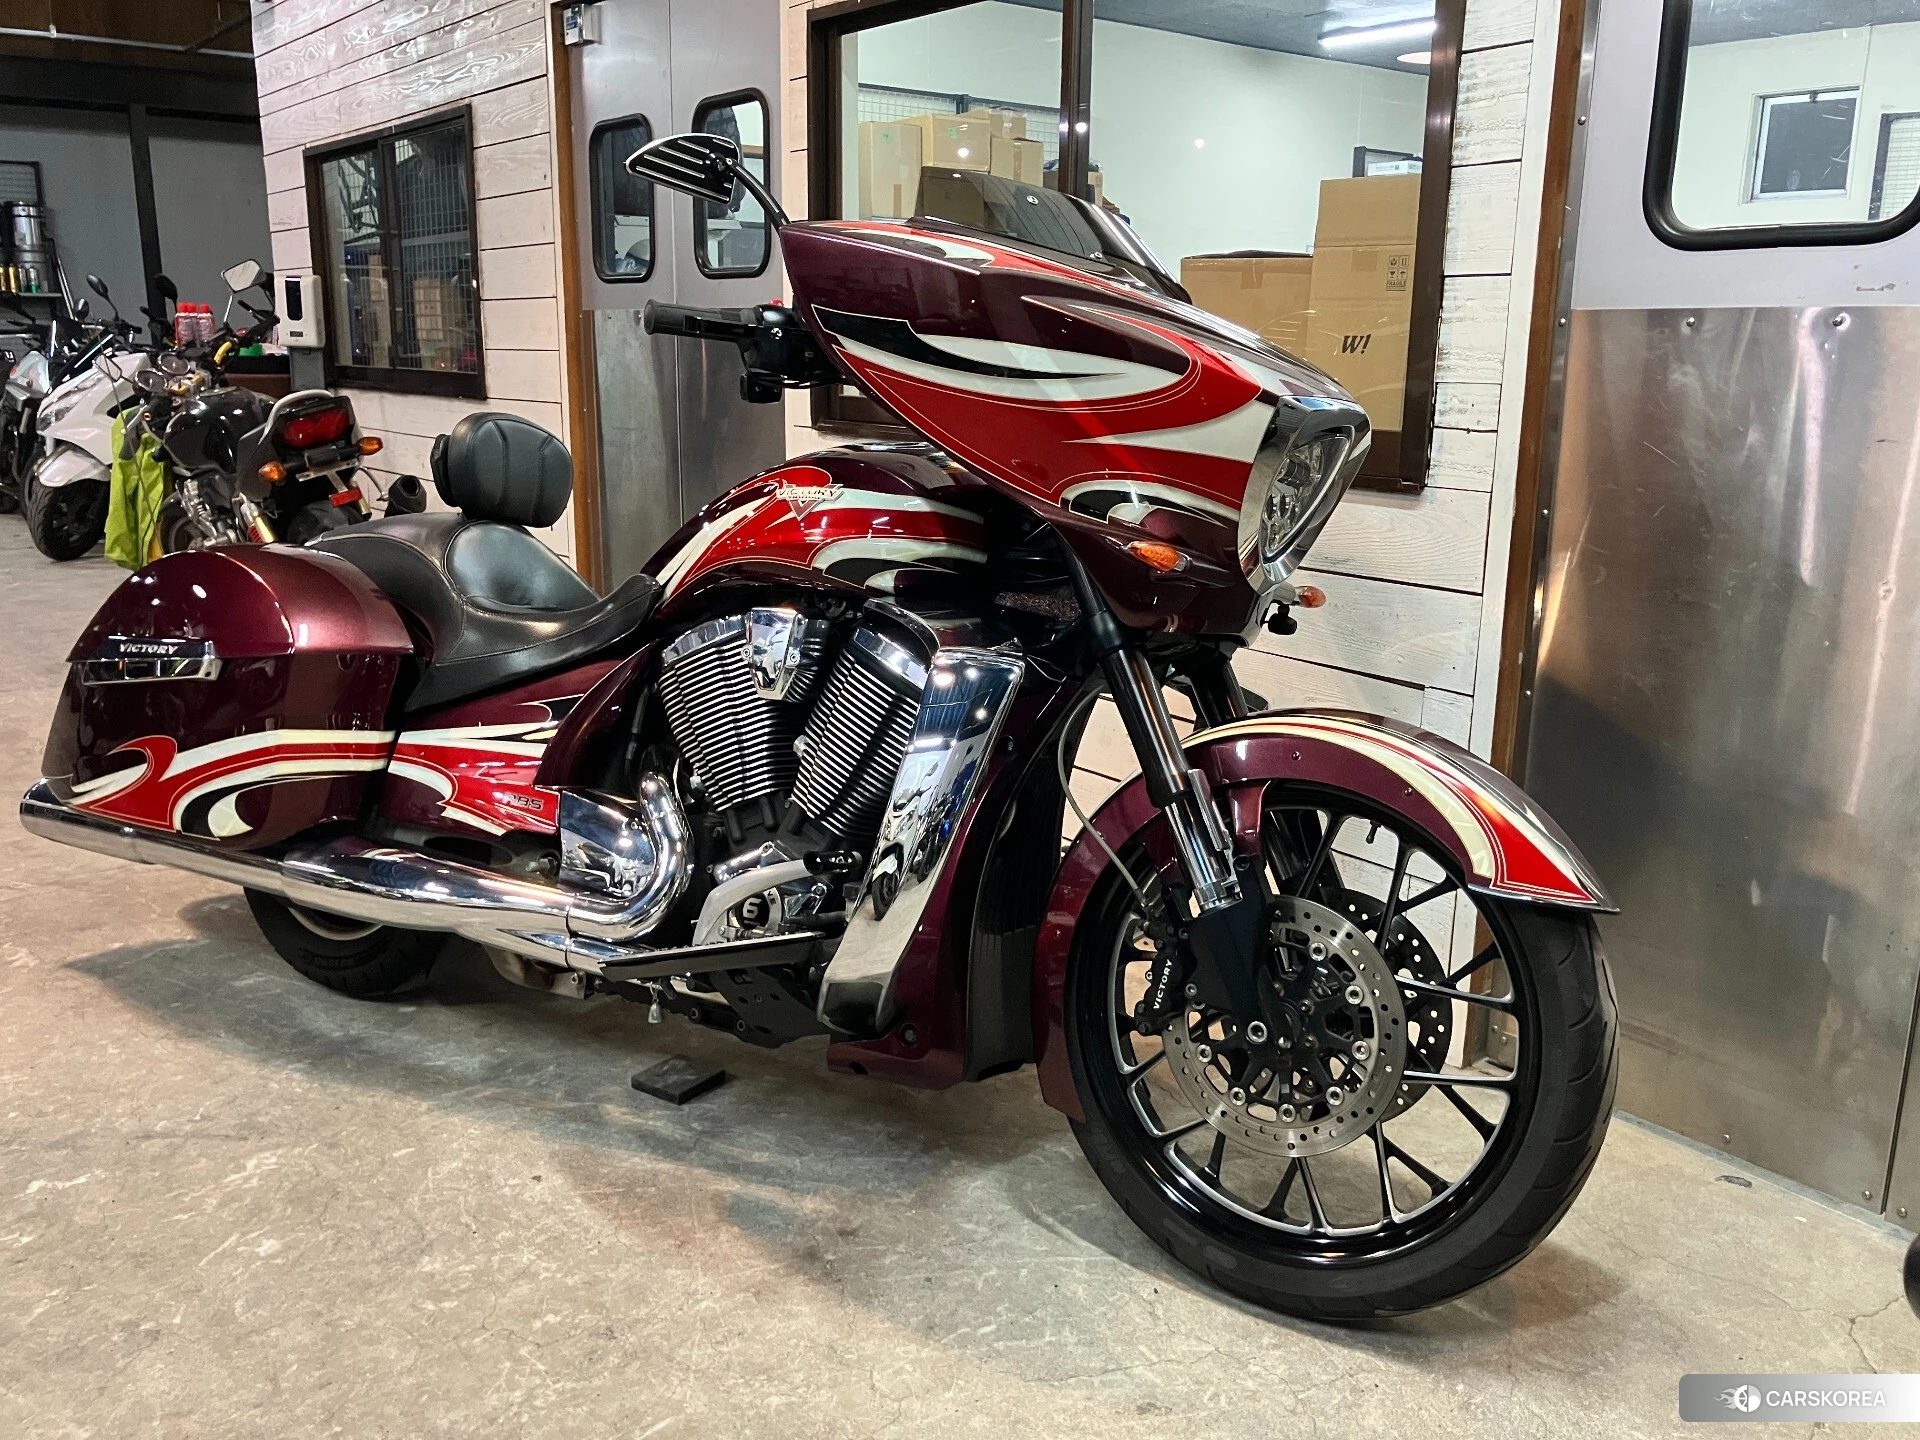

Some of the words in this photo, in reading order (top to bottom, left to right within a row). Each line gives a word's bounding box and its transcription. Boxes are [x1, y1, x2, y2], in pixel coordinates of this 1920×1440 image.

[1341, 334, 1371, 354] W!
[119, 642, 178, 655] VICTORY
[1153, 959, 1173, 1009] VICTORY
